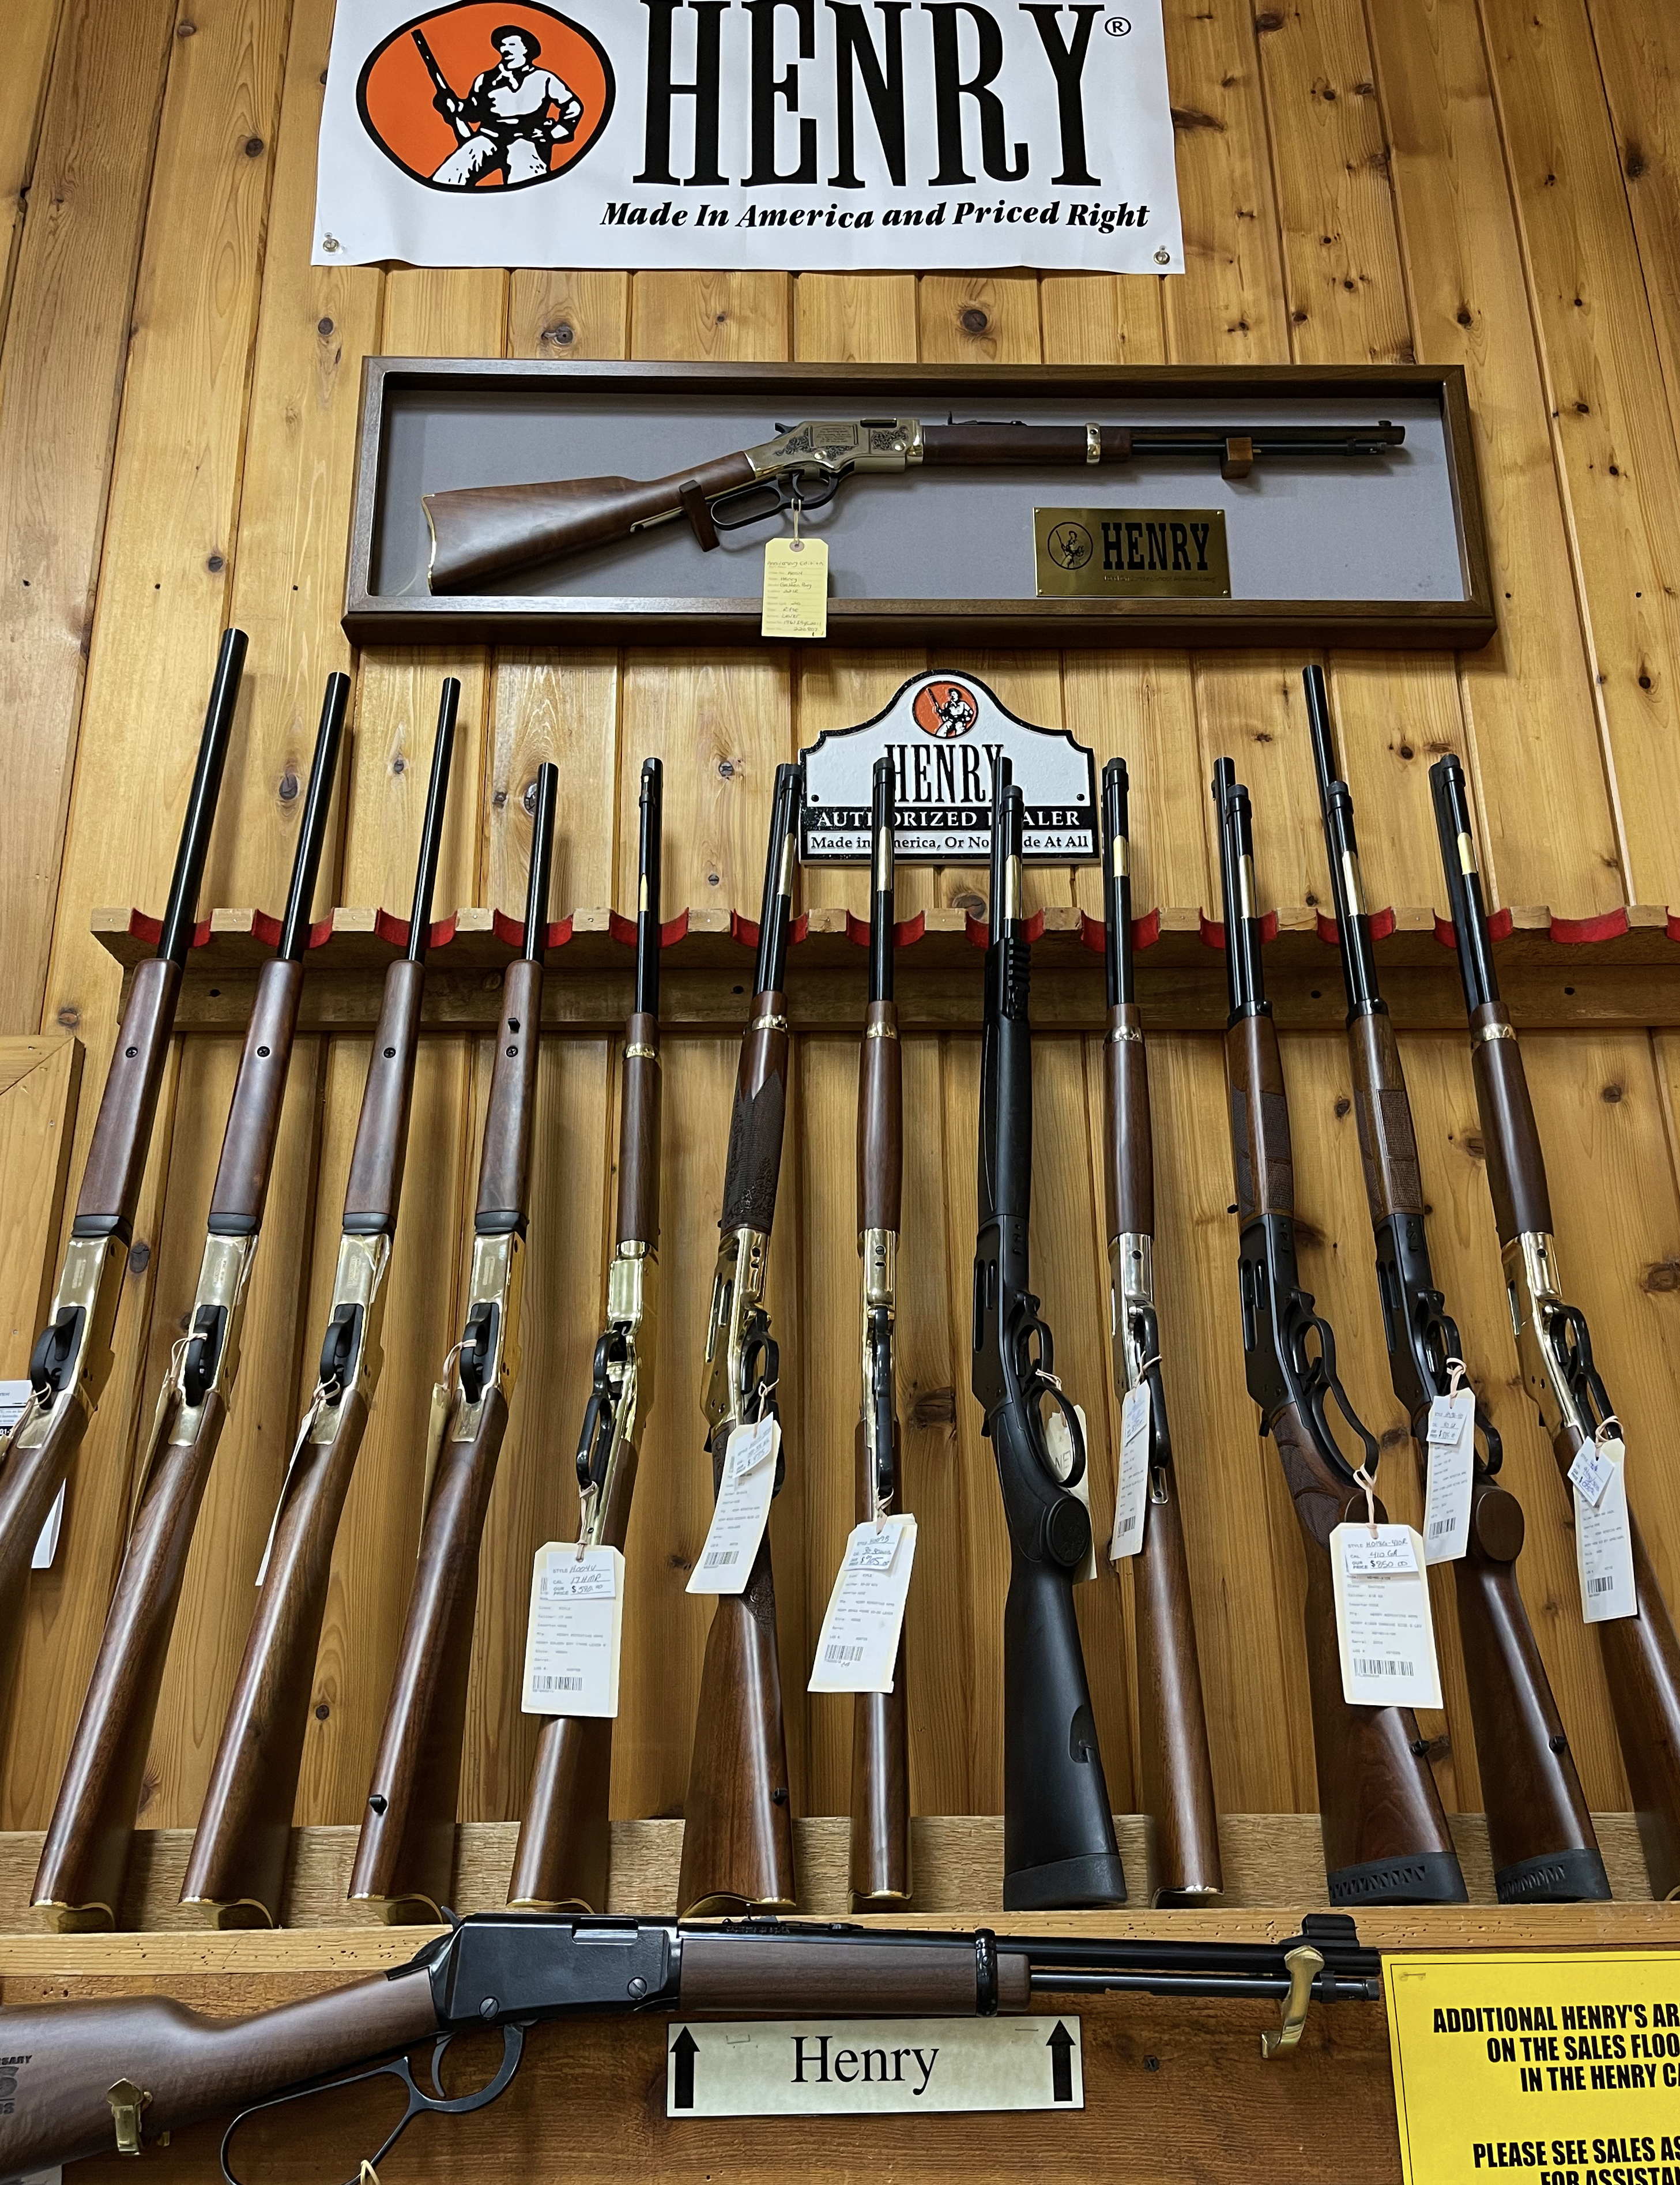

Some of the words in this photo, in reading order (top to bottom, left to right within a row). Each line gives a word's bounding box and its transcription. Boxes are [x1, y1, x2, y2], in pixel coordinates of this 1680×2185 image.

[599, 201, 688, 227] Made
[694, 204, 729, 227] In
[734, 203, 875, 229] America
[882, 201, 947, 226] and
[952, 200, 1060, 225] Priced
[1065, 202, 1150, 234] Right
[1101, 522, 1210, 570] HENRY
[884, 744, 1004, 803] HENRY
[817, 811, 977, 826] AUTRIZED
[811, 837, 852, 848] Made
[857, 837, 871, 848] in
[944, 837, 965, 848] Or
[969, 836, 991, 848] No
[1044, 836, 1061, 848] At
[1065, 836, 1088, 847] All
[1387, 1549, 1398, 1557] GA
[1433, 2006, 1558, 2033] ADDITIONAL
[1561, 2003, 1648, 2030] HENRY'S
[1653, 2003, 1680, 2028] AR
[1487, 2037, 1516, 2063] ON
[1520, 2036, 1560, 2062] THE
[1564, 2034, 1626, 2061] SALES
[1630, 2033, 1680, 2059] FLOO
[790, 2035, 940, 2096] Henry
[1520, 2067, 1543, 2092] IN
[1546, 2066, 1587, 2092] THE
[1589, 2063, 1657, 2090] HENRY
[1662, 2062, 1680, 2088] C
[1472, 2141, 1548, 2168] PLEASE
[1551, 2139, 1589, 2165] SEE
[1592, 2137, 1656, 2164] SALES
[1540, 2170, 1580, 2185] FOR
